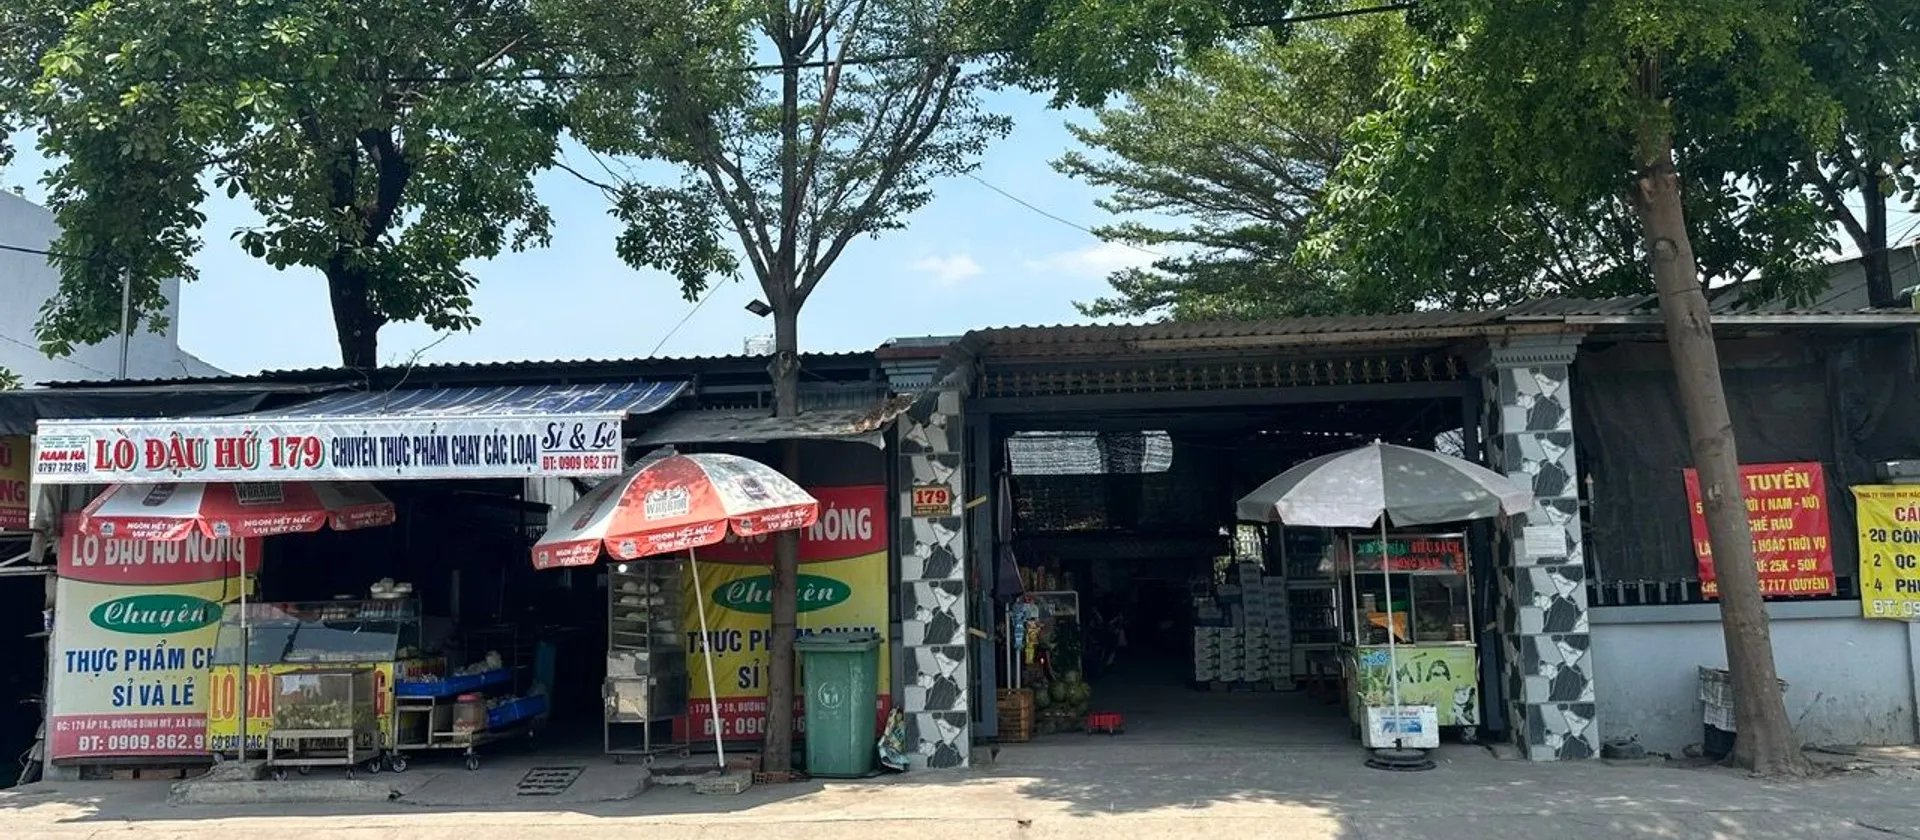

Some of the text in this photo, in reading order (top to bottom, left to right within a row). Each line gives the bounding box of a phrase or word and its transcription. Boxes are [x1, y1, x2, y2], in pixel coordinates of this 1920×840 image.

[541, 421, 619, 451] Sỉ & Lẻ
[39, 451, 68, 461] NAM
[94, 427, 139, 471] LÒ
[145, 430, 207, 477] ĐẬU
[268, 436, 325, 470] 179
[331, 421, 537, 474] CHUYÊN THỰC PHẨM CHAY CÁC LOẠI
[542, 454, 619, 470] ĐT: 0909 862 977
[1746, 467, 1811, 491] TUYỂN
[915, 490, 946, 504] 179
[1696, 502, 1704, 514] 5
[1768, 497, 1793, 511] NAM
[808, 502, 872, 542] NÓNG
[1771, 517, 1794, 531] RAU
[1759, 538, 1785, 554] HOẶC
[1787, 534, 1811, 550] THỜI
[1812, 536, 1827, 553] VỤ
[1869, 528, 1887, 543] 20
[1769, 560, 1788, 573] 25K
[1797, 558, 1818, 572] 50K
[1873, 553, 1917, 570] 2 QC
[726, 581, 835, 604] Chên
[1767, 579, 1787, 592] 717
[1788, 577, 1830, 593] (DUYÊN)
[1873, 578, 1883, 593] 4
[103, 601, 208, 628] Chuyên
[65, 648, 119, 677] THỰC
[124, 639, 187, 672] PHẨM
[737, 658, 761, 689] SỈ
[112, 676, 196, 707] SỈ VÀ LẺ
[79, 733, 204, 751] ĐT: 0909.862.9
